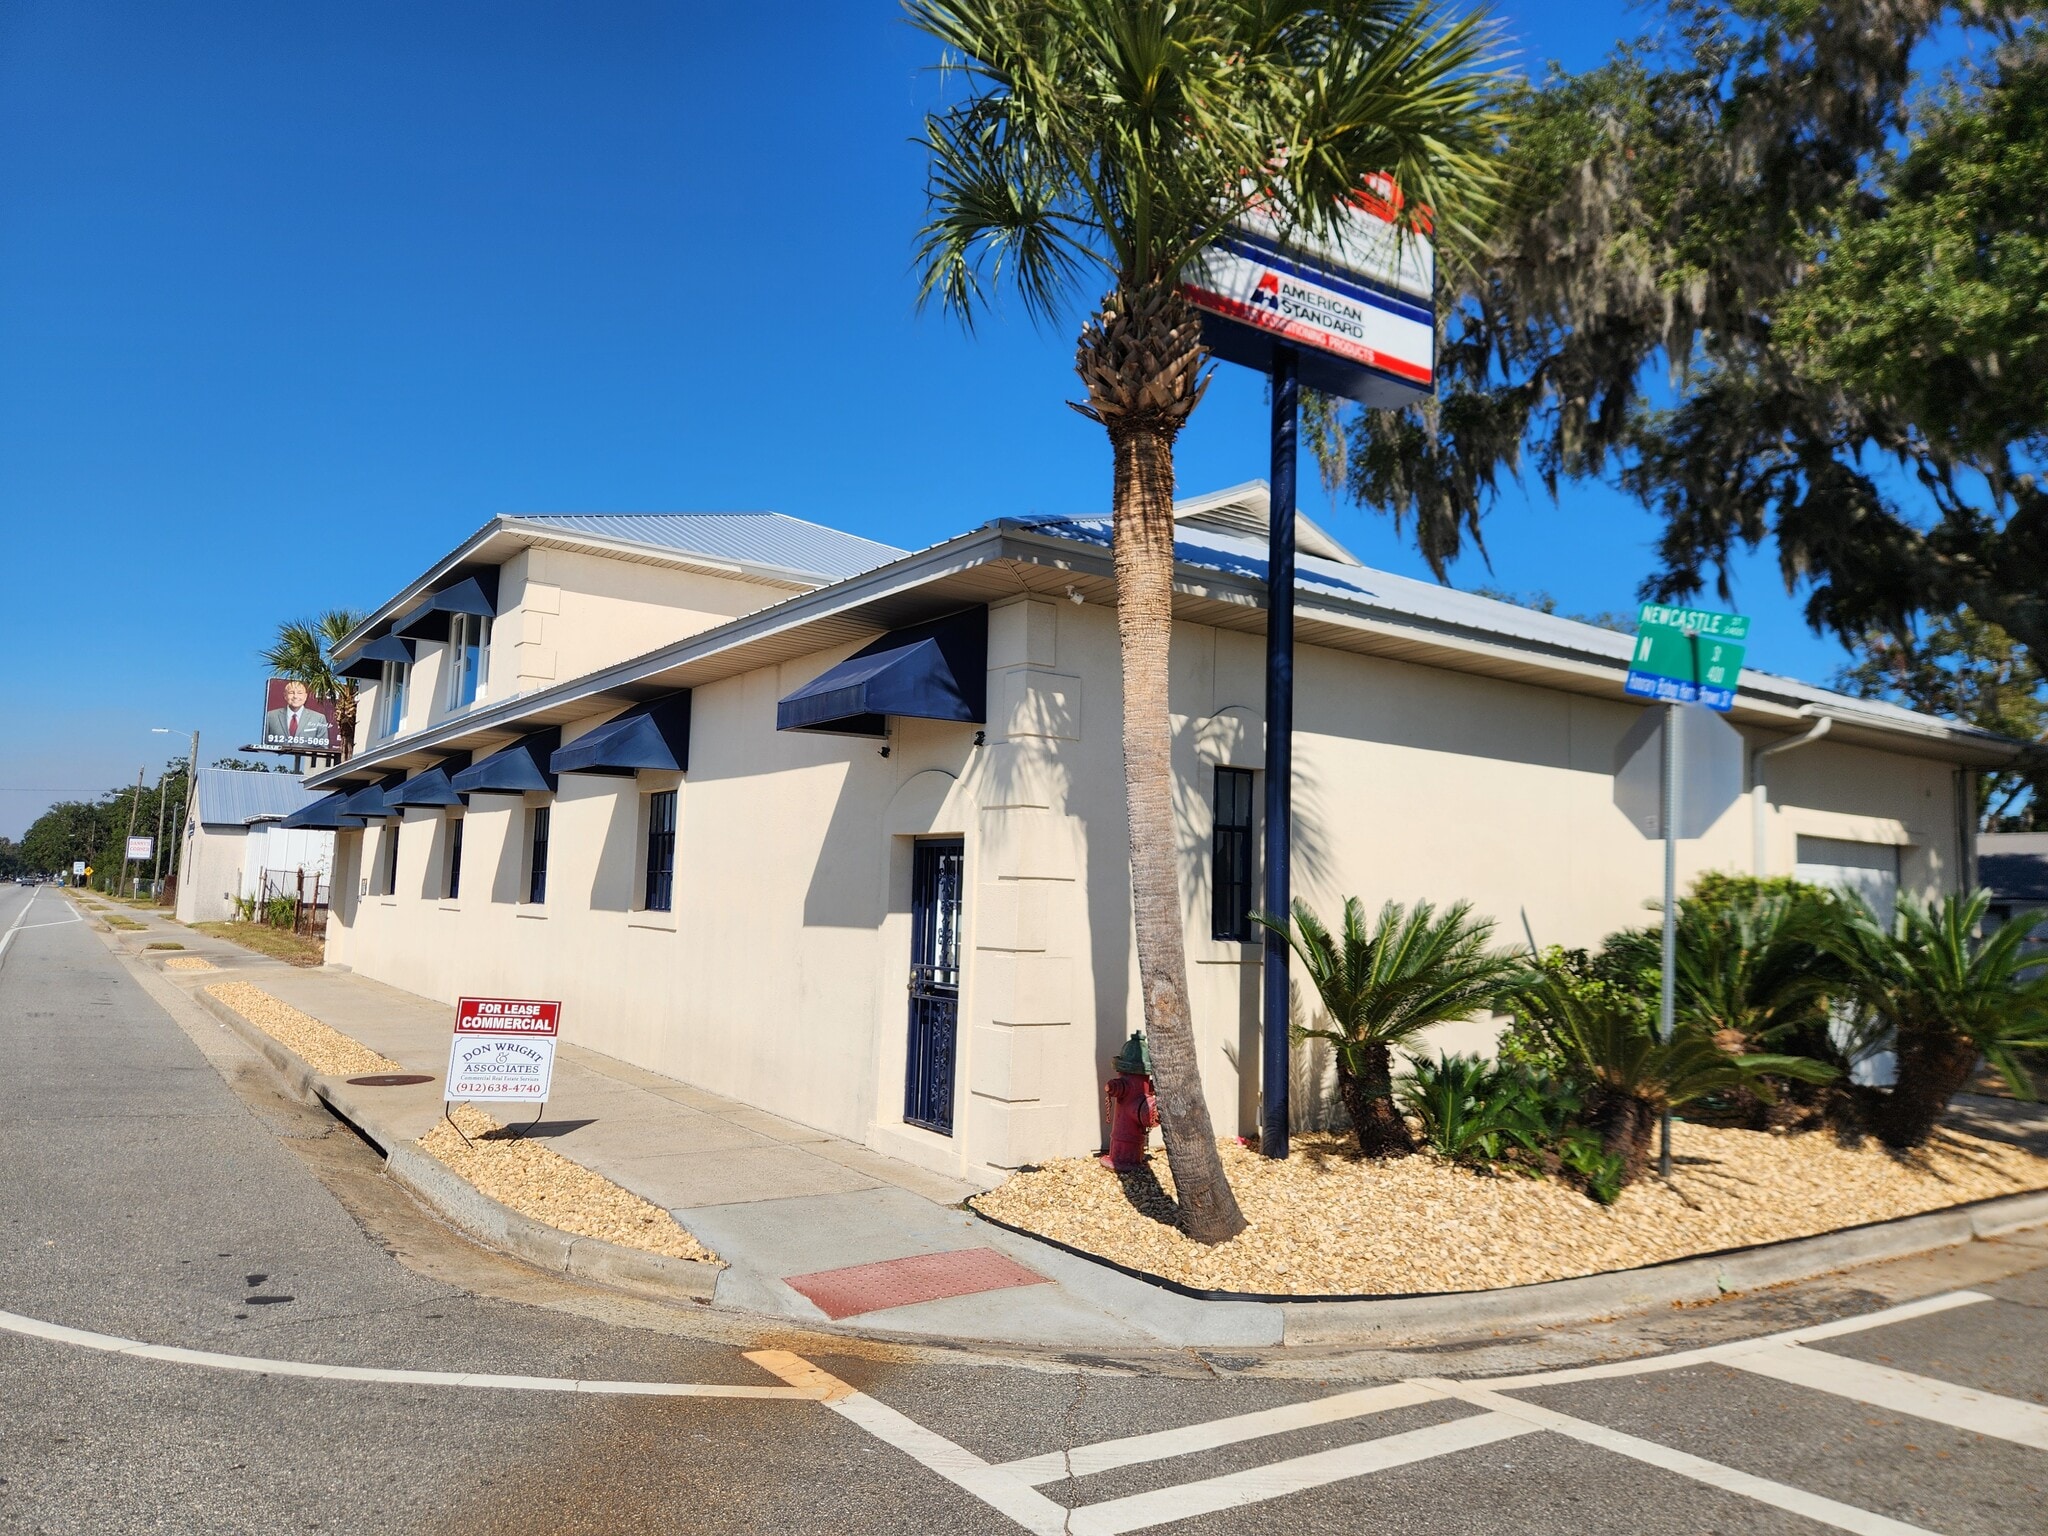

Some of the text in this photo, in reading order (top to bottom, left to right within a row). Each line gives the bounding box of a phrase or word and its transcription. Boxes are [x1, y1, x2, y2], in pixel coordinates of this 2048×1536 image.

[1281, 283, 1362, 322] AMERICAN
[1281, 299, 1363, 339] STANDARD
[1328, 335, 1375, 364] PRODUCTS
[1641, 605, 1723, 634] NEWCASTLE
[1638, 635, 1653, 662] N
[268, 734, 330, 746] 912-265-5069
[478, 1003, 541, 1015] FOR LEASE
[462, 1016, 552, 1031] COMMERCIAL
[462, 1042, 543, 1063] DON WRIGHT
[496, 1051, 509, 1064] &
[464, 1063, 539, 1074] ASSOCIATES
[456, 1082, 541, 1094] (912)638-4740
